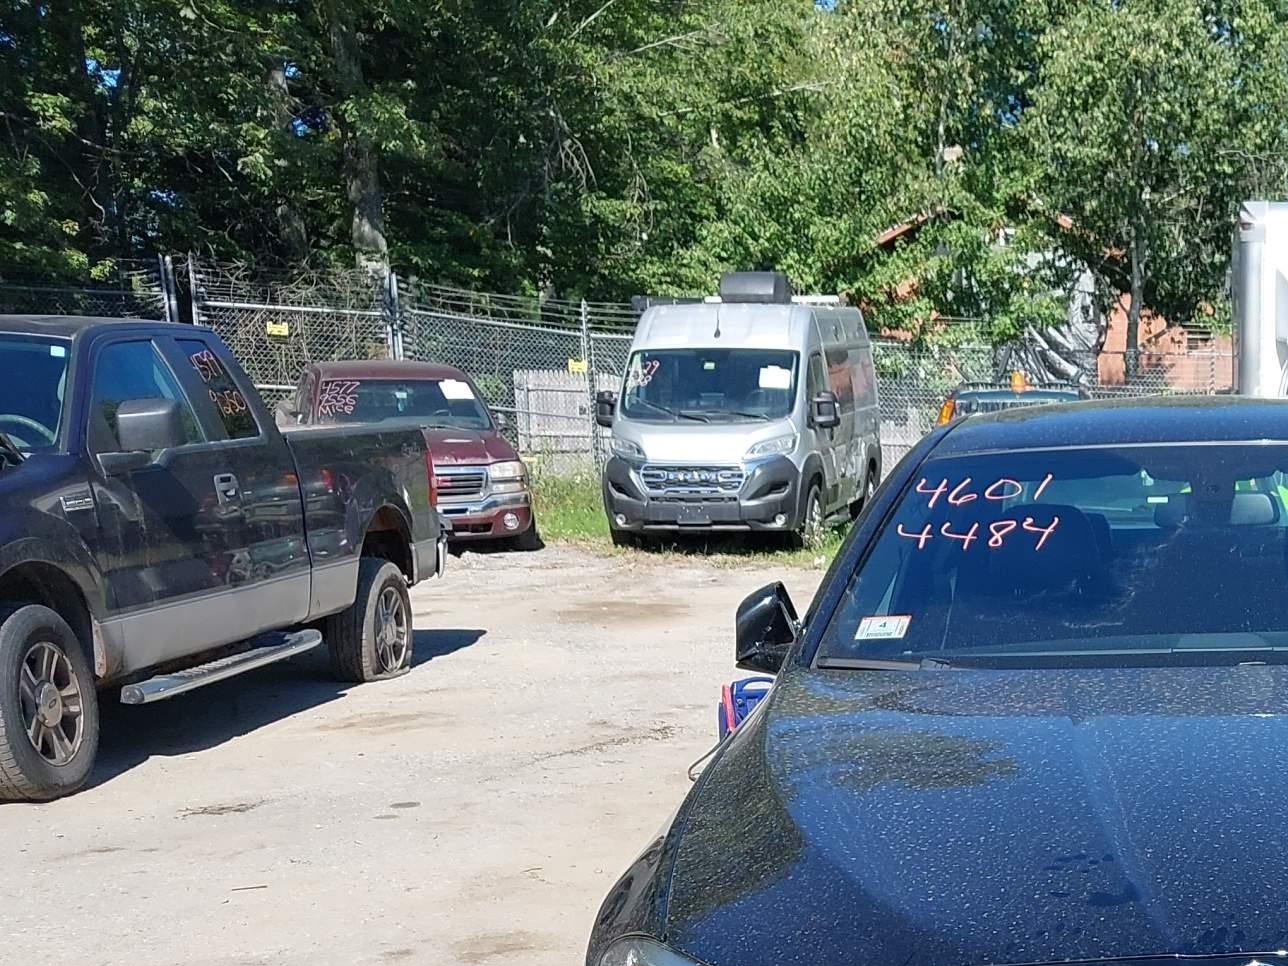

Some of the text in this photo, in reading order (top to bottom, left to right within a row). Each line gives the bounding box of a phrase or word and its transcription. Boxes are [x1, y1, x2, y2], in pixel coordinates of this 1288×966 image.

[321, 381, 361, 394] 4577
[319, 393, 360, 406] 9556
[916, 474, 1053, 509] 4601
[897, 516, 1059, 550] 4484
